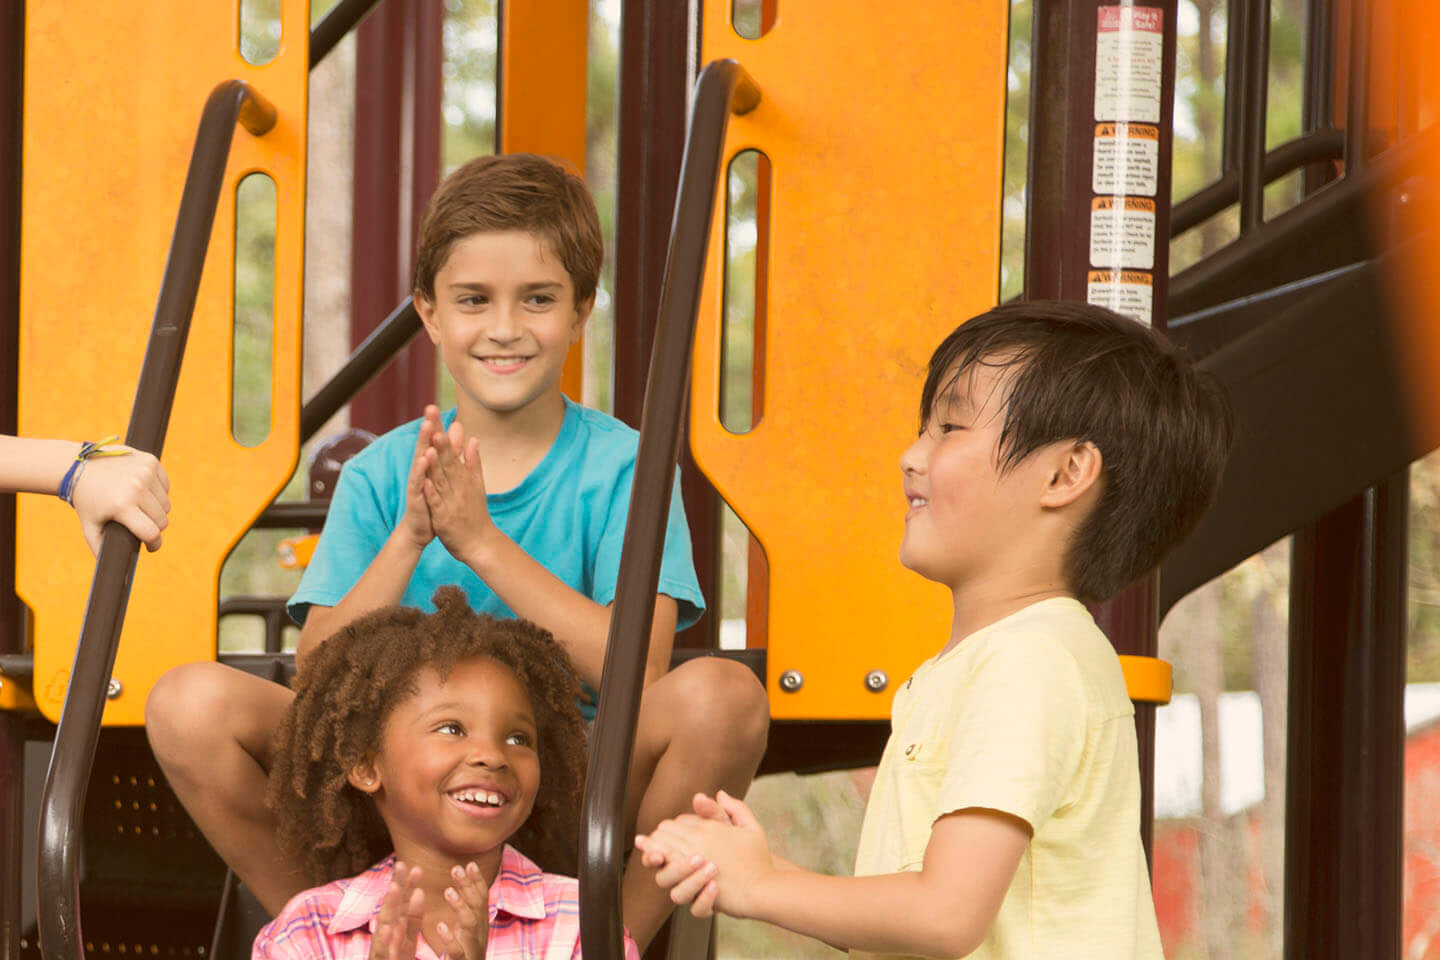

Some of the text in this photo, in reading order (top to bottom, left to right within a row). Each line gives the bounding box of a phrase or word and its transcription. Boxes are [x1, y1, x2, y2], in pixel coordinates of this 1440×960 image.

[1111, 126, 1156, 138] WRNING
[1109, 198, 1153, 210] WRNING
[1103, 272, 1150, 285] WRNING
